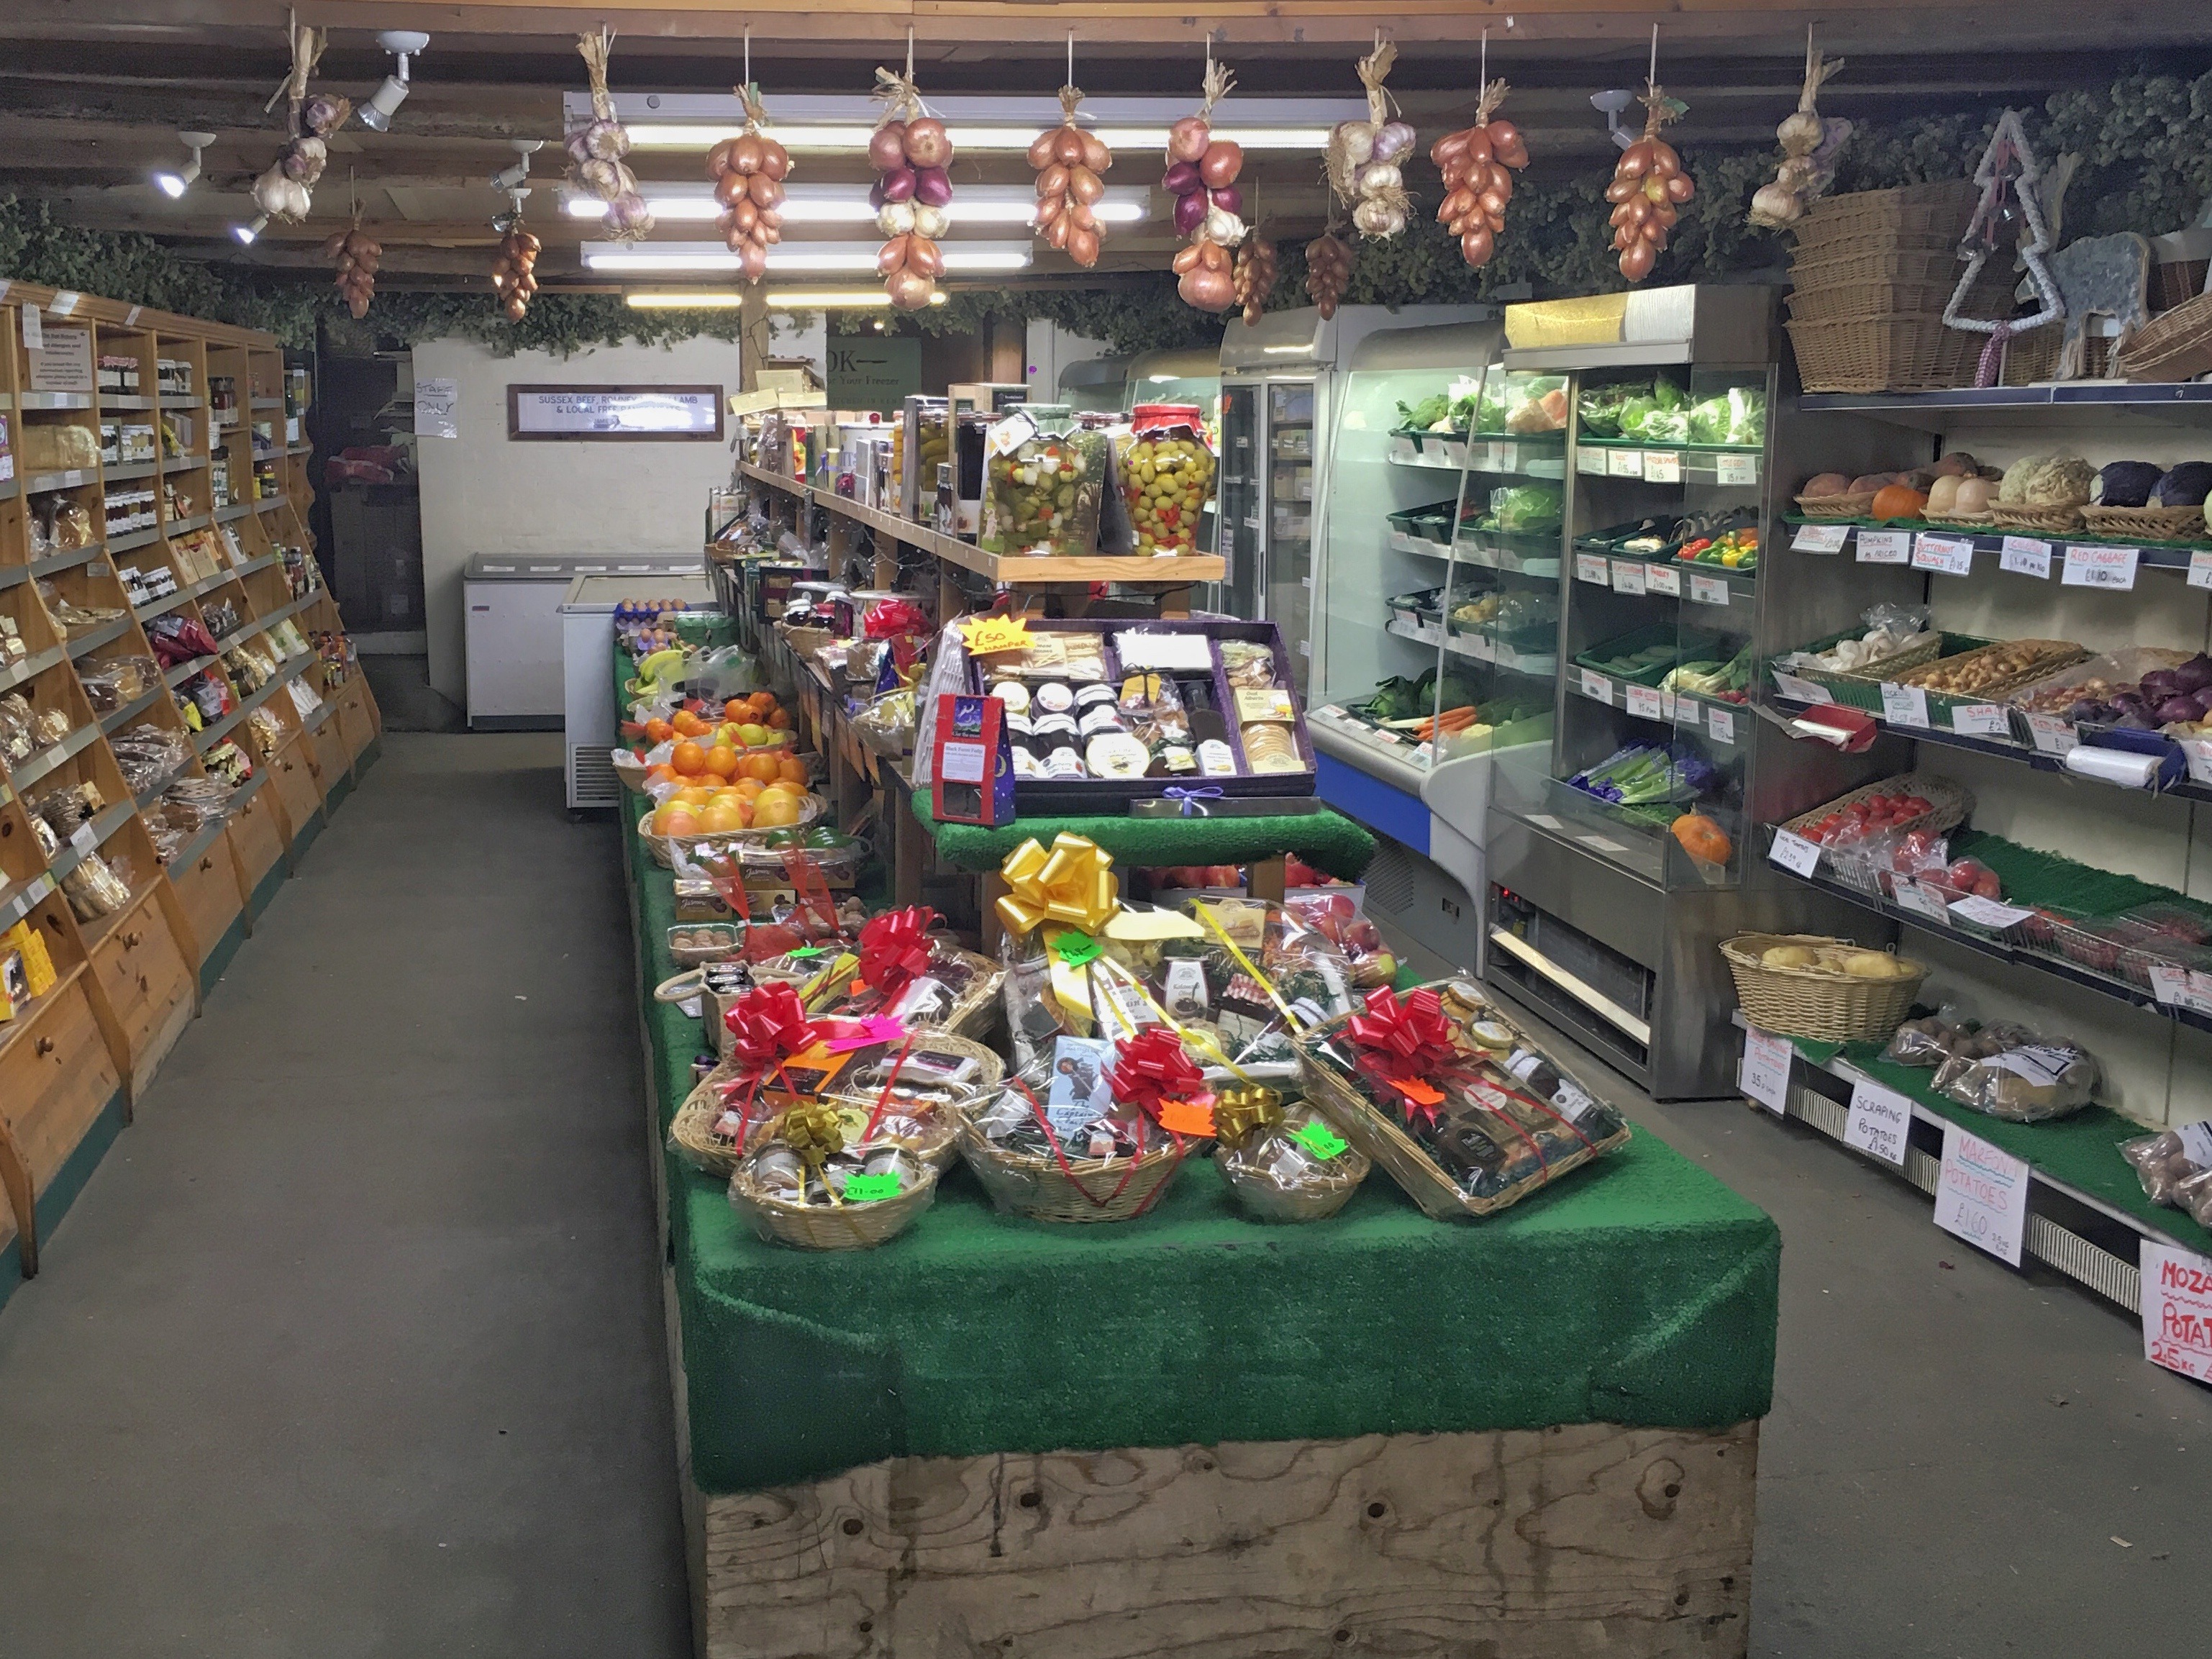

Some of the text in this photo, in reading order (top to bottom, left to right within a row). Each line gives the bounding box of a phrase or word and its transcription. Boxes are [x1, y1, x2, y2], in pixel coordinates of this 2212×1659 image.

[839, 376, 861, 385] Your
[865, 376, 899, 385] Freezer
[417, 401, 454, 412] ONLY
[1860, 534, 1893, 545] PUMPKINS
[1917, 539, 1955, 554] BUTTERNUT
[1875, 550, 1897, 558] PRICED
[1916, 552, 1944, 565] SQUASH
[2070, 548, 2128, 564] RED CABBAGE
[975, 631, 1006, 646] £50
[1856, 1096, 1903, 1124] SCRAPING
[1858, 1117, 1897, 1145] POTATOES
[1945, 1158, 2008, 1210] POTATOES
[2161, 1260, 2212, 1294] MOZA
[2162, 1301, 2212, 1349] POTAT
